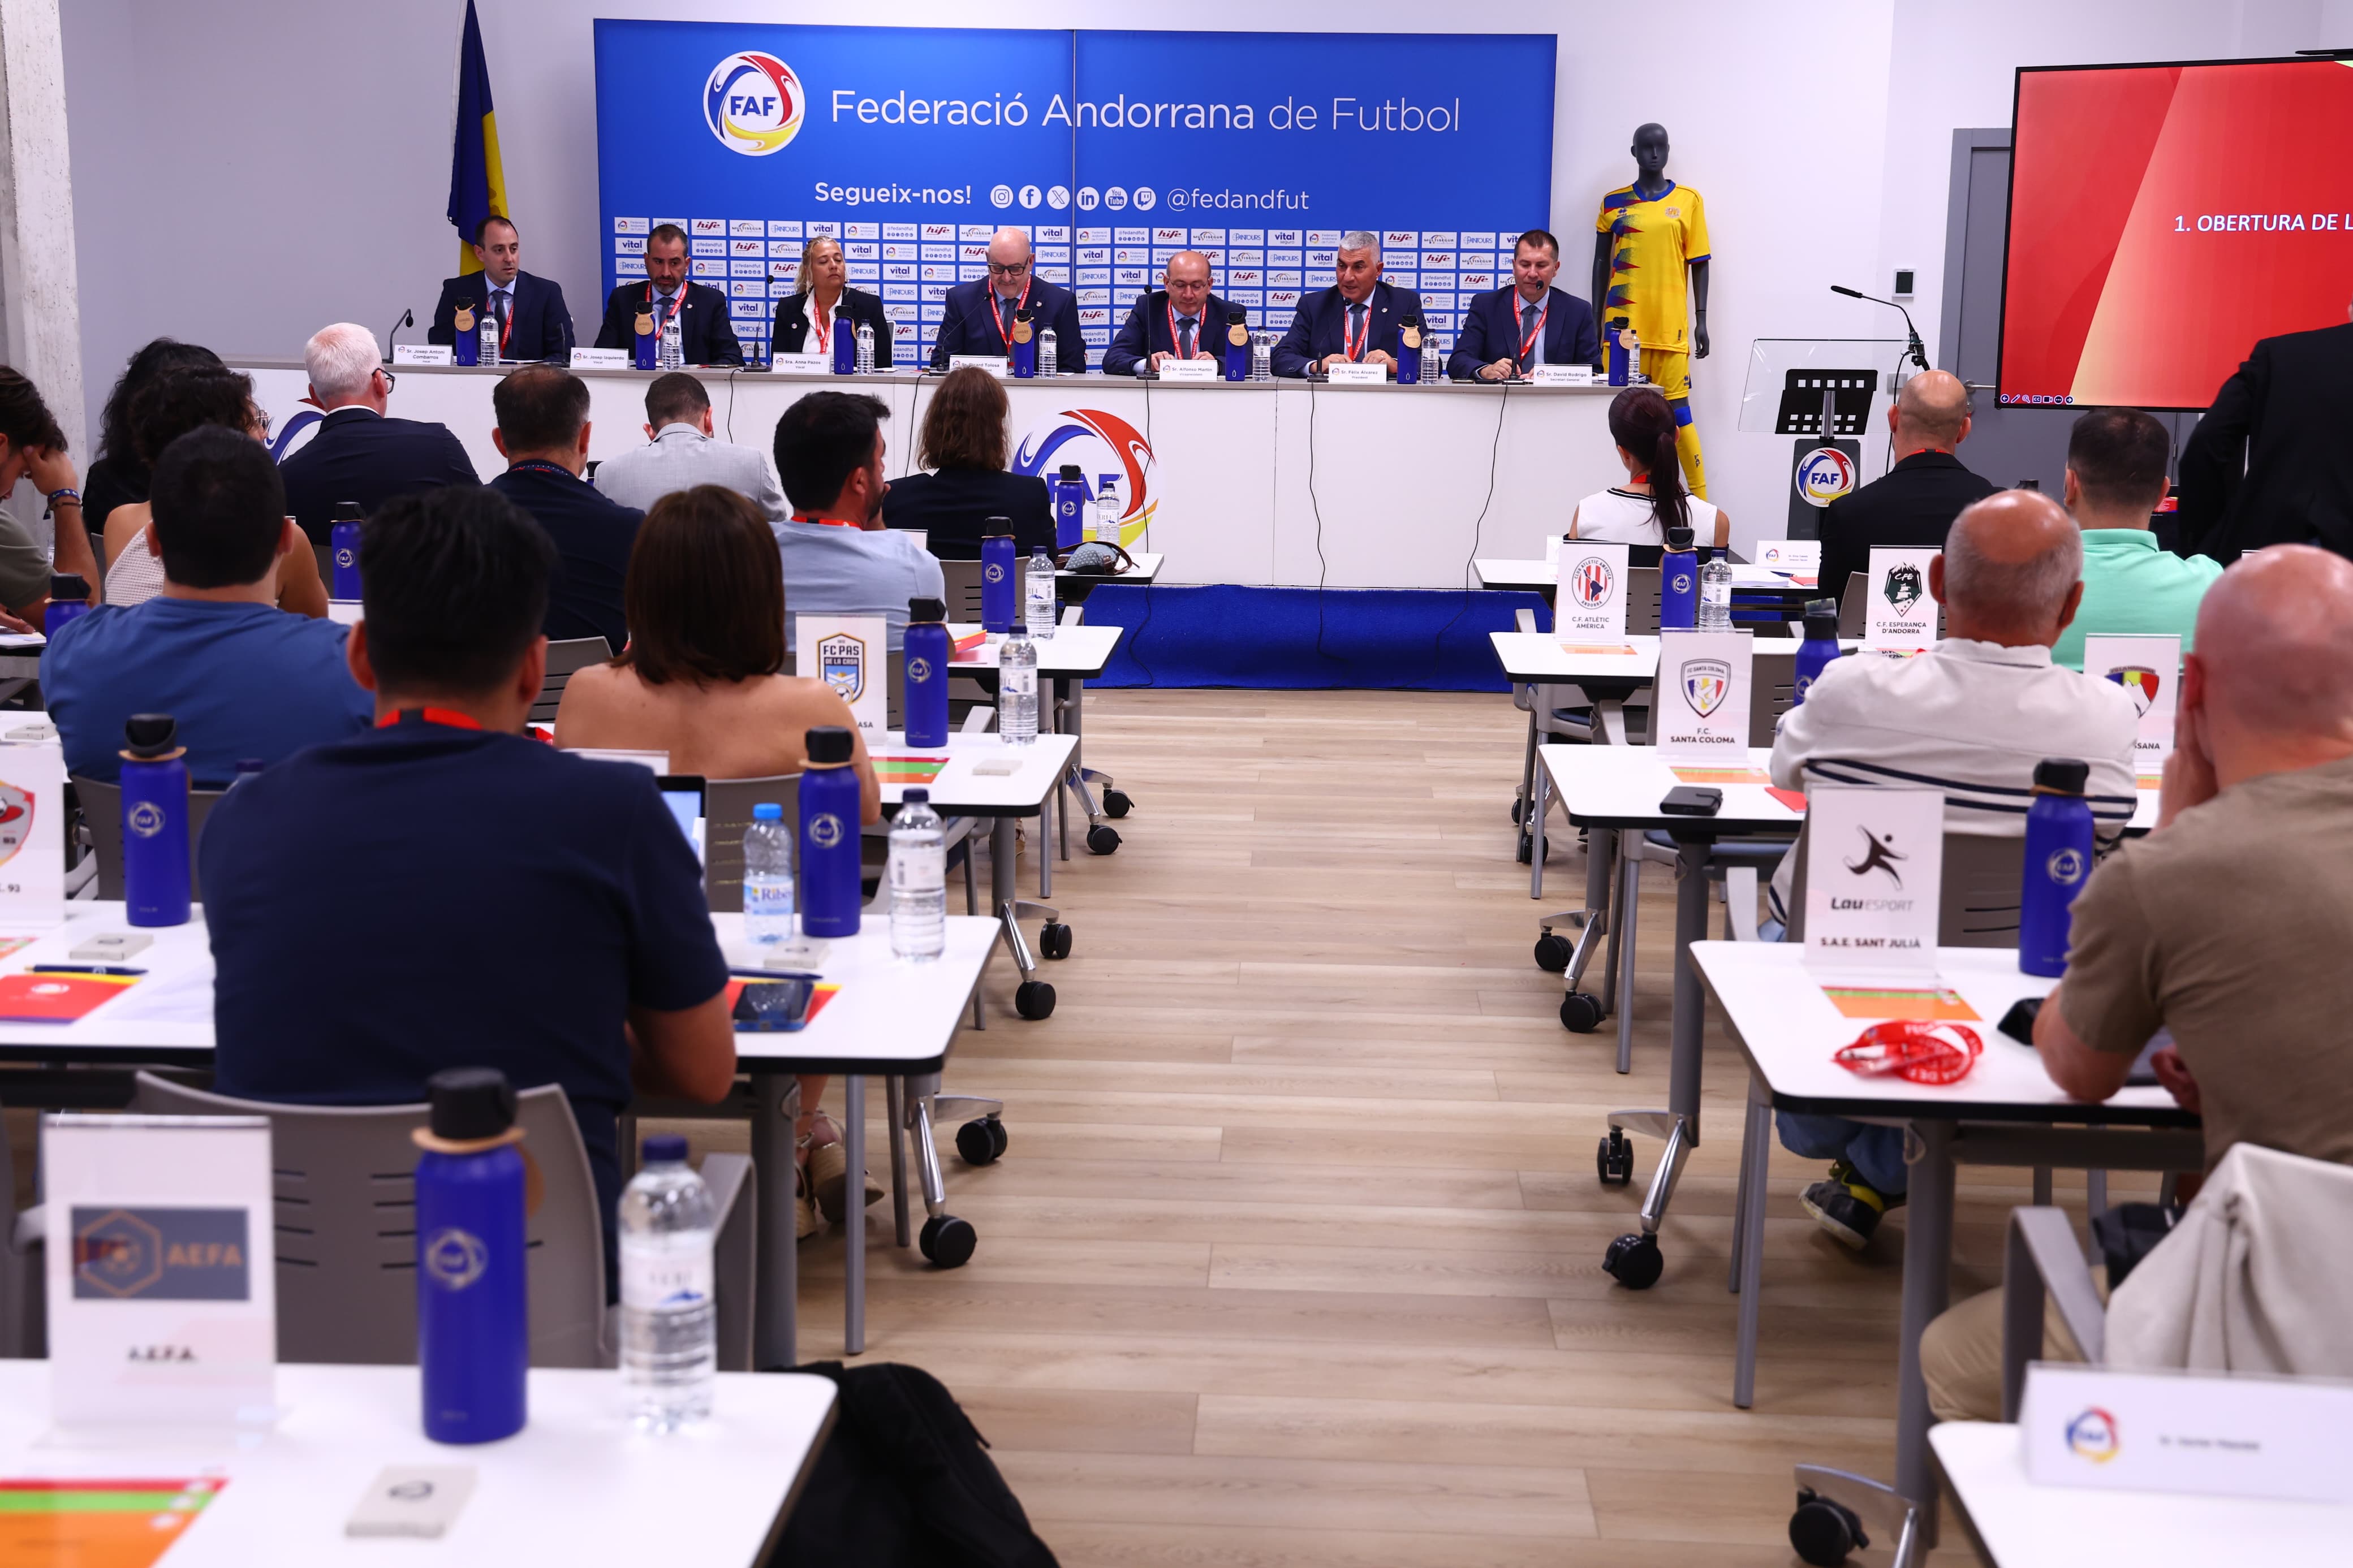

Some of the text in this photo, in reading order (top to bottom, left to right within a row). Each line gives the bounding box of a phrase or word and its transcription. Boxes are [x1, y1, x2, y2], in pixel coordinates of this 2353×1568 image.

[730, 95, 777, 116] FAF
[832, 90, 1459, 131] Federació Andorrana de Futbol
[815, 183, 1309, 212] Segueix-nos! @fedandfut
[813, 223, 833, 232] vital
[2174, 215, 2191, 232] 1.
[2197, 214, 2305, 231] OBERTURA
[2312, 214, 2338, 230] DE
[1274, 231, 1294, 240] vital
[622, 239, 642, 248] vital
[851, 244, 871, 253] vital
[1083, 249, 1103, 258] vital
[1121, 270, 1141, 279] vital
[1811, 473, 1840, 485] FAF
[824, 645, 859, 655] FC PAS
[1855, 938, 1885, 947] SANT
[166, 1244, 243, 1267] AEFA
